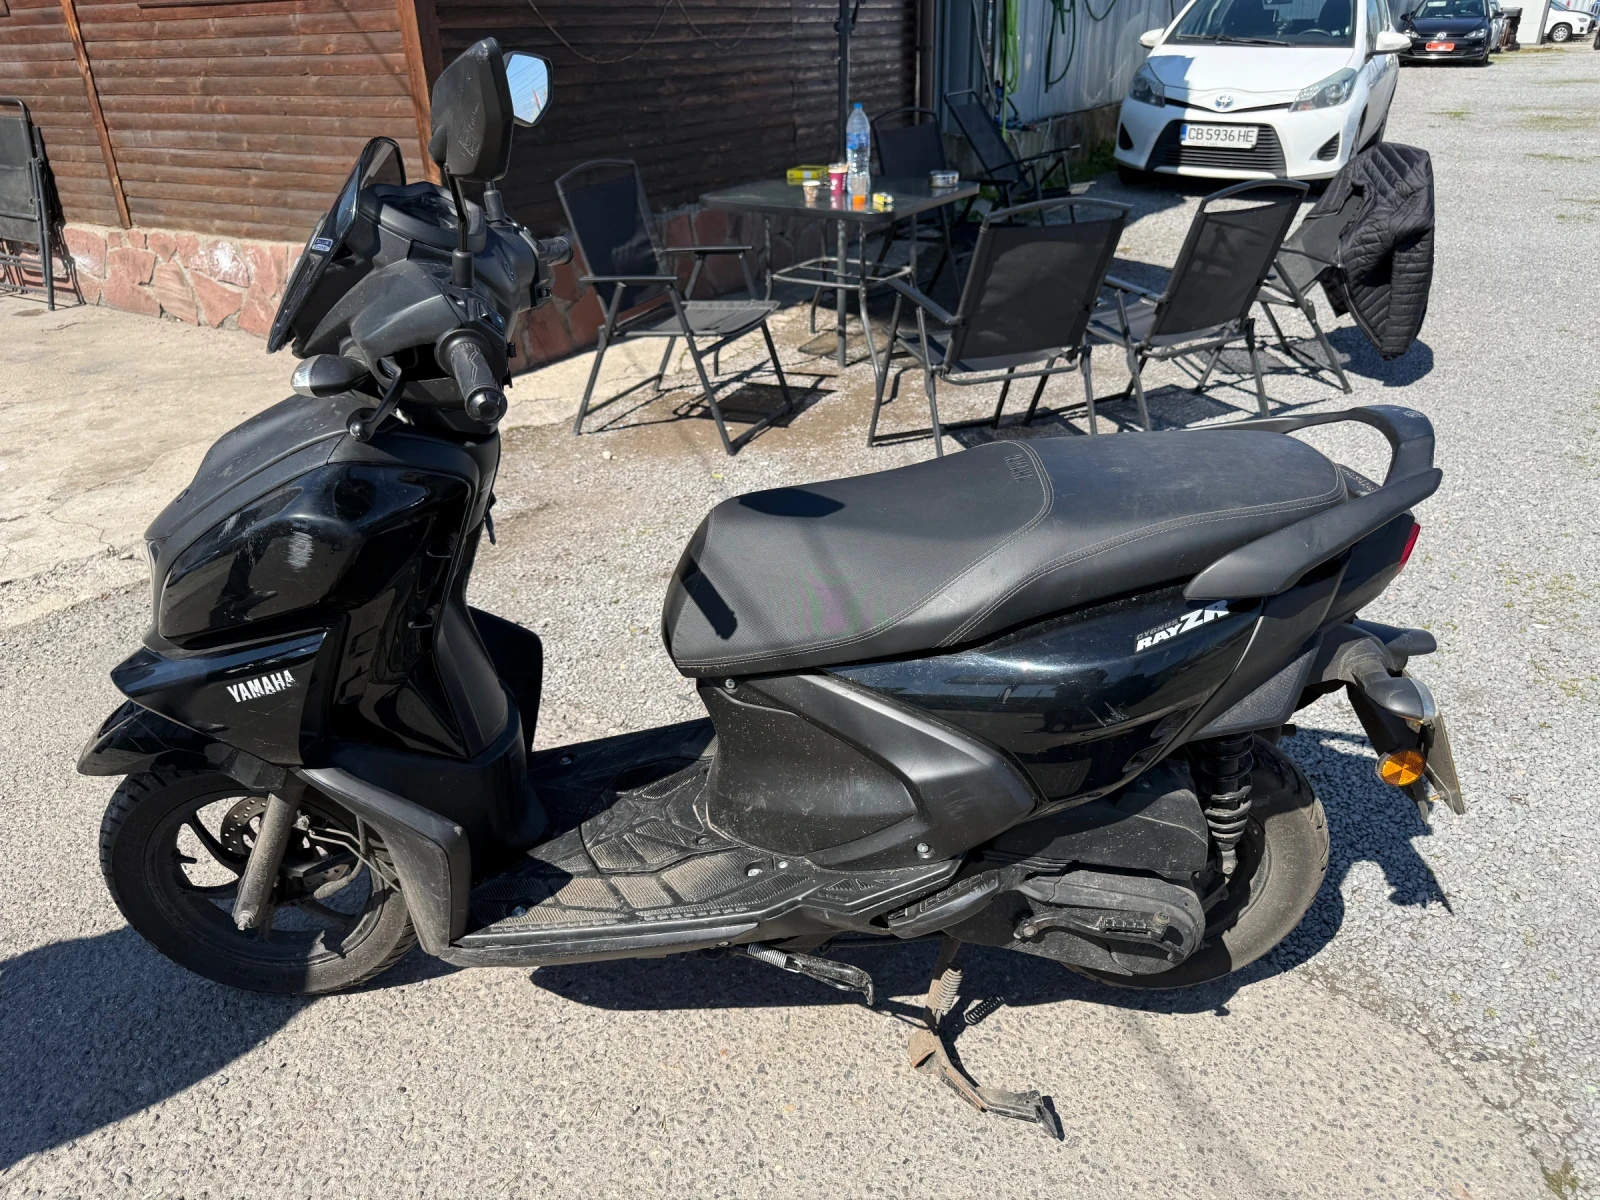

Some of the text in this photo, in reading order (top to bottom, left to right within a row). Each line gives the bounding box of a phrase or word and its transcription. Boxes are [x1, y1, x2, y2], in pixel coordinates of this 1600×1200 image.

[1188, 127, 1255, 143] CB 5936 HE
[1136, 619, 1179, 640] CYGNUS
[226, 669, 300, 703] YAMAHA
